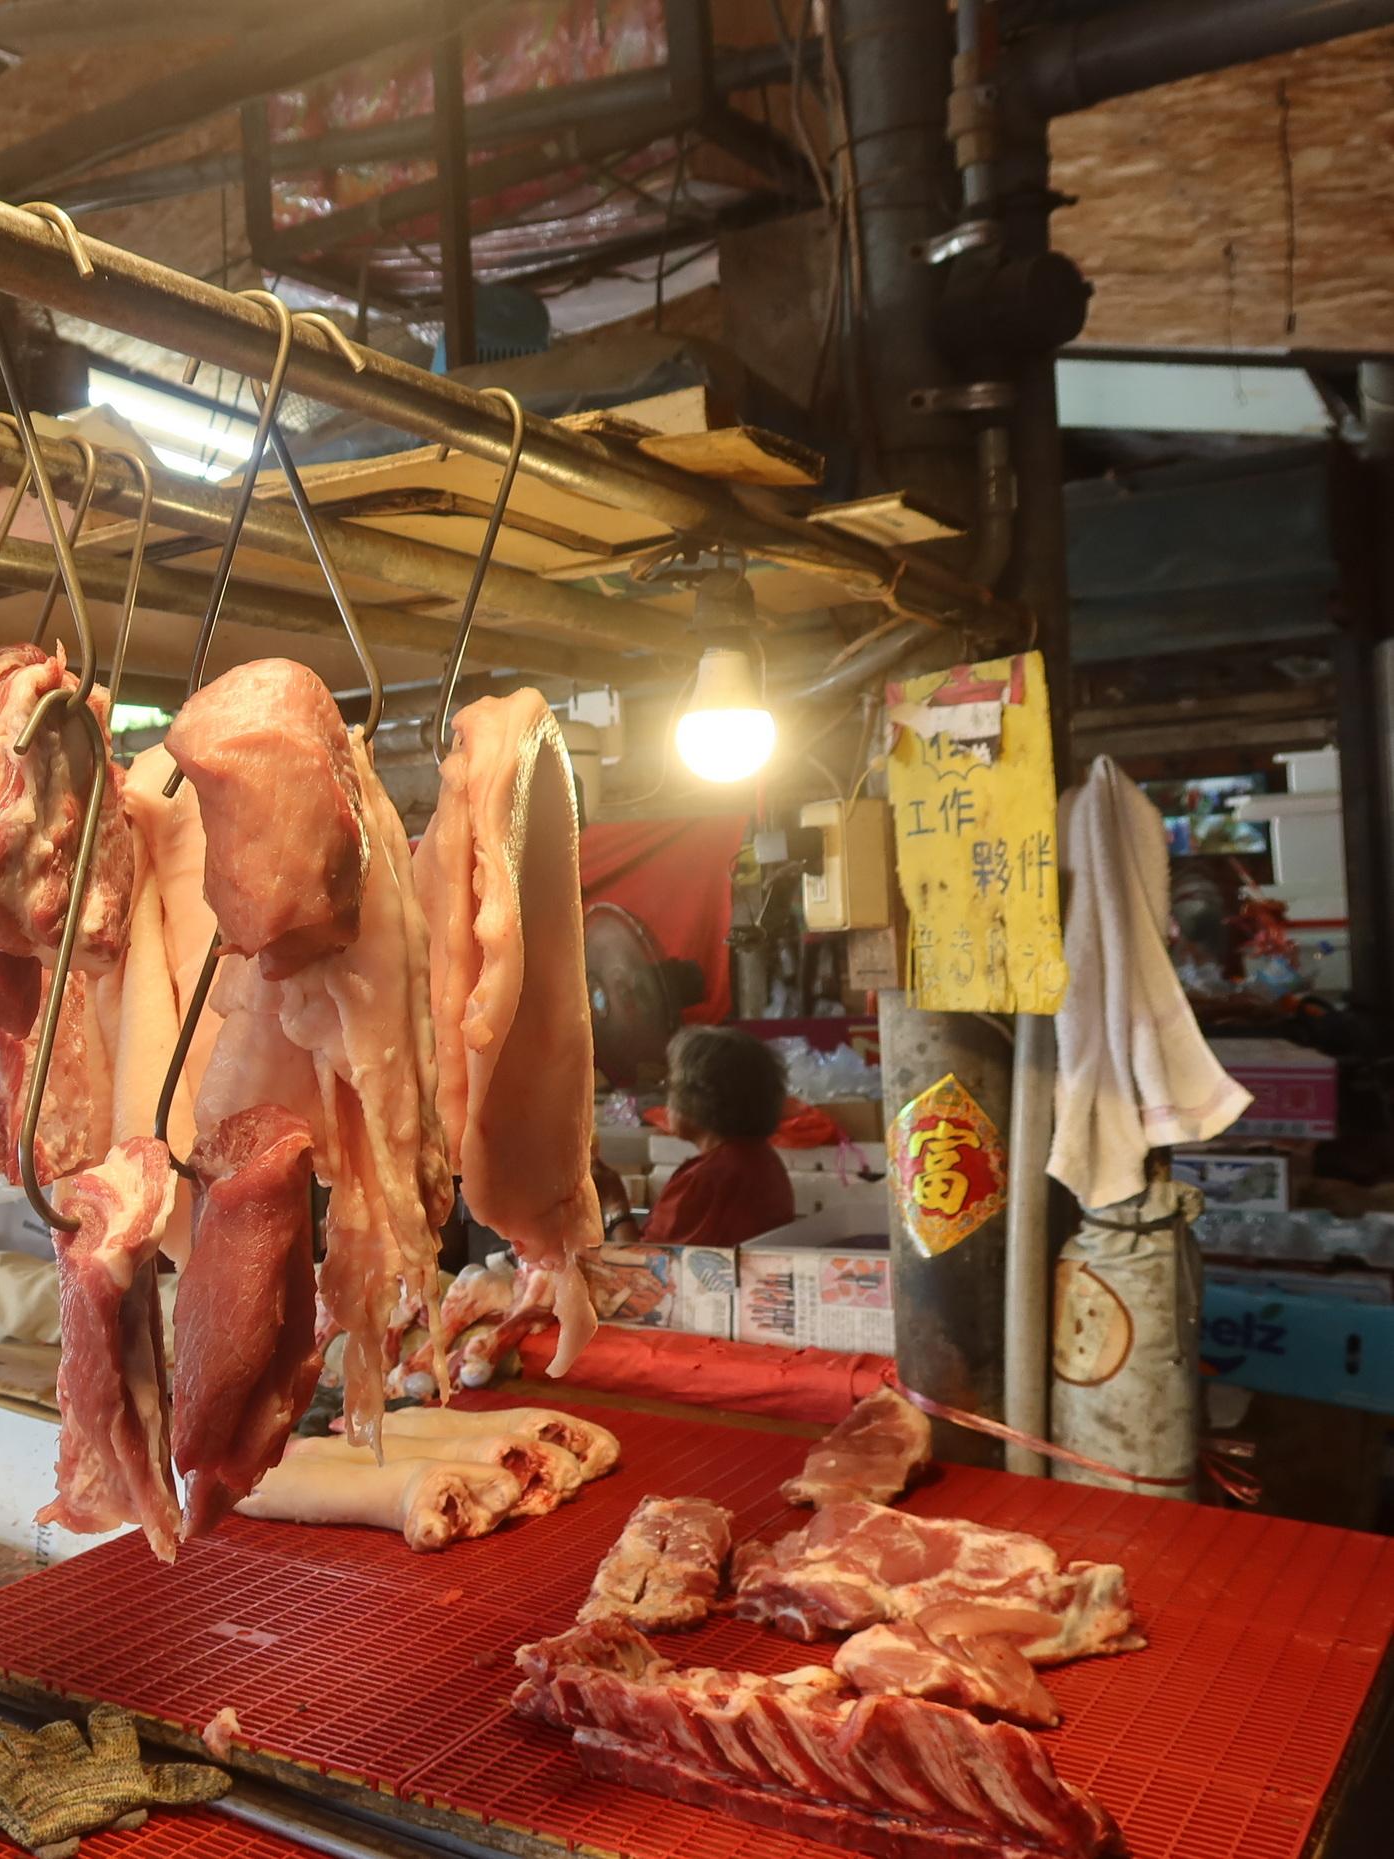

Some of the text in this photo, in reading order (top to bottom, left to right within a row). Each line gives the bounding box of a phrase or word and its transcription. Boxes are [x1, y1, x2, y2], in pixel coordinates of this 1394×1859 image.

[907, 787, 977, 837] 工作
[971, 829, 1055, 898] 夥伴
[908, 1120, 982, 1216] 富
[1200, 1311, 1288, 1356] elz
